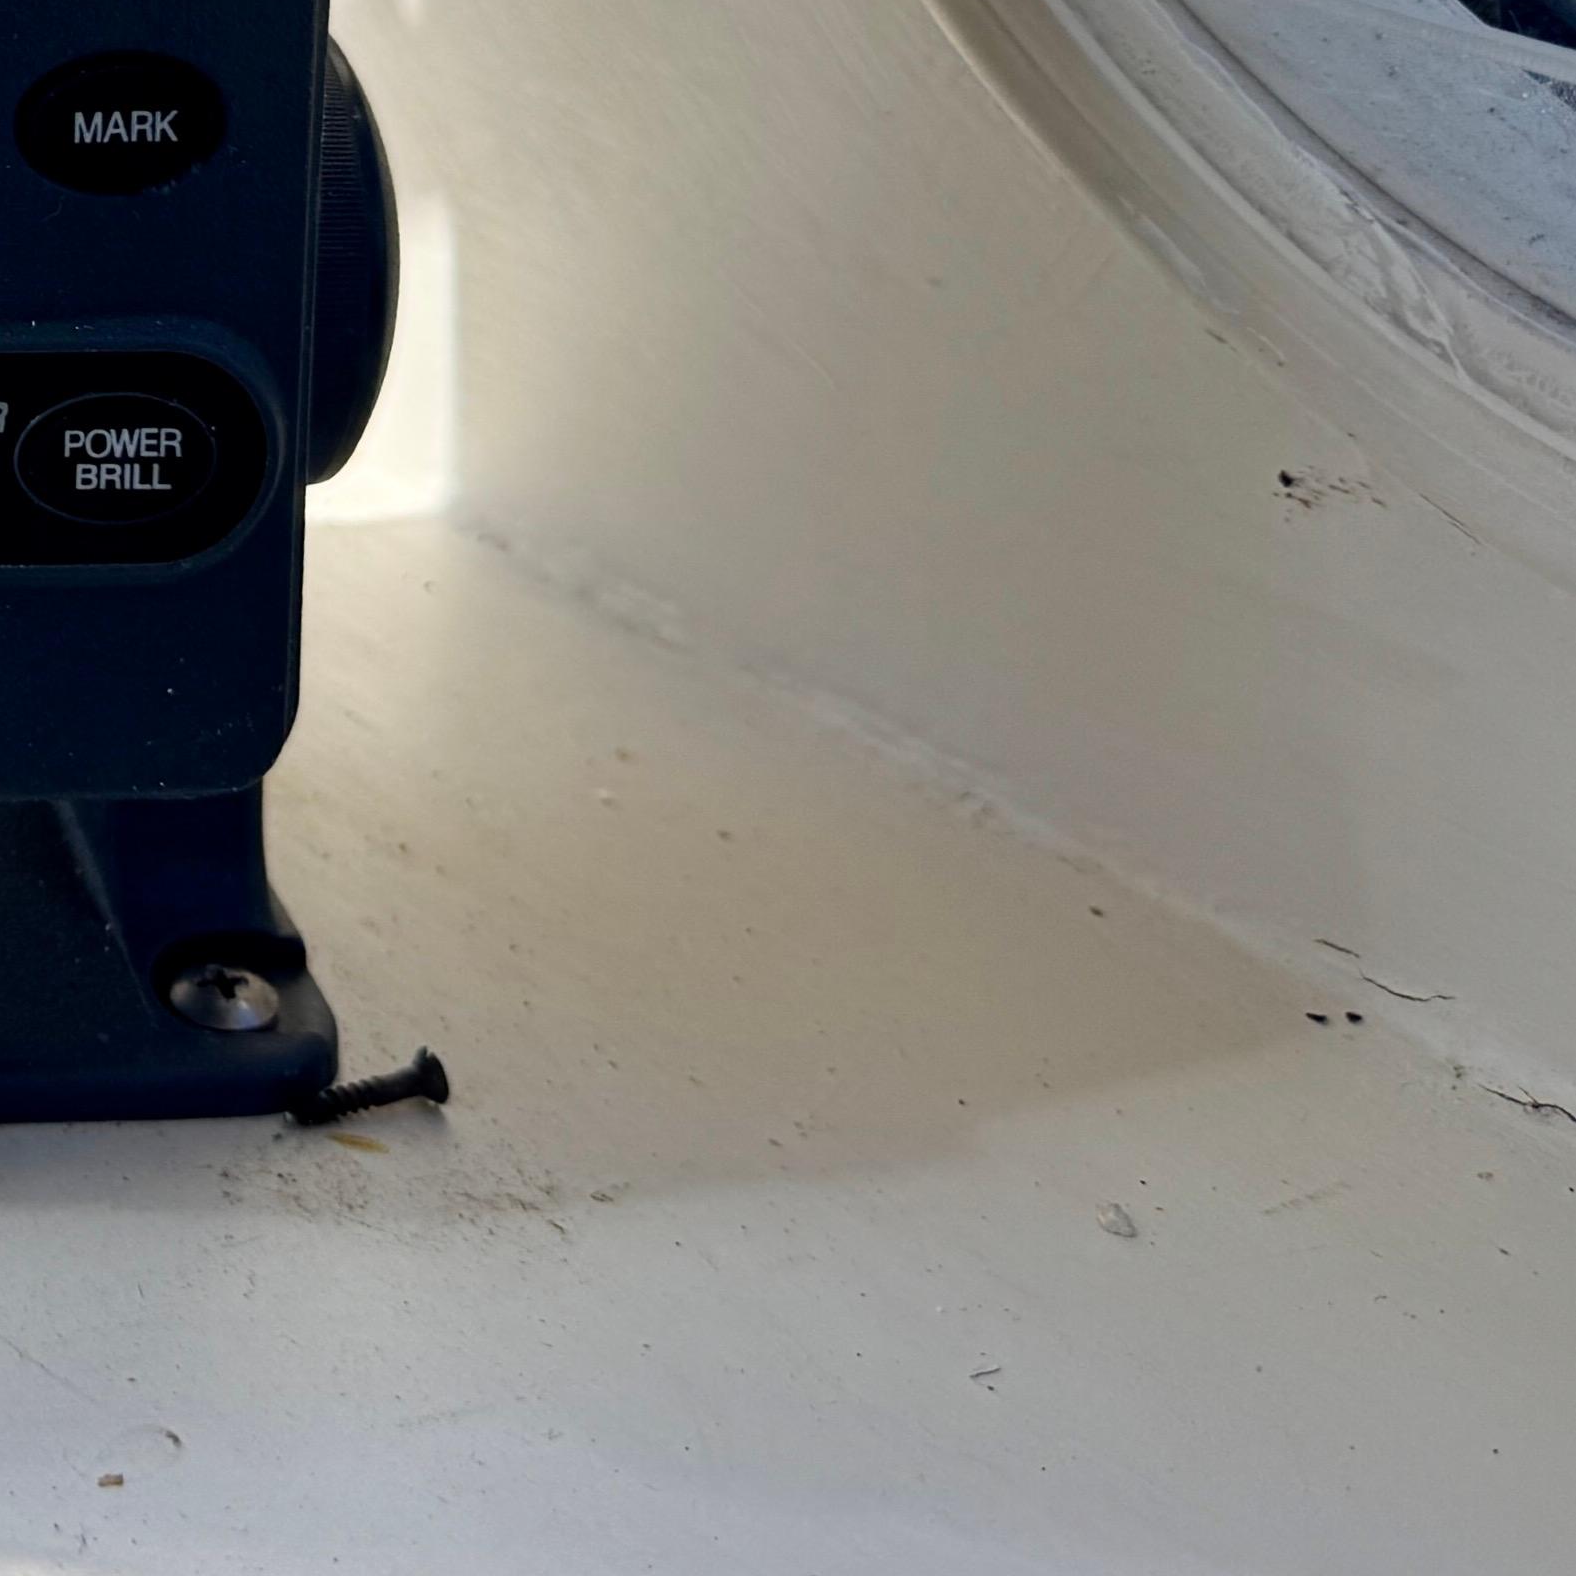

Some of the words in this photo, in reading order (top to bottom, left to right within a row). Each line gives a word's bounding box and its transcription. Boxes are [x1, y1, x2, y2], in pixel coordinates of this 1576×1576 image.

[72, 110, 179, 144] MARK
[63, 427, 183, 459] POWER
[75, 463, 172, 491] BRILL
